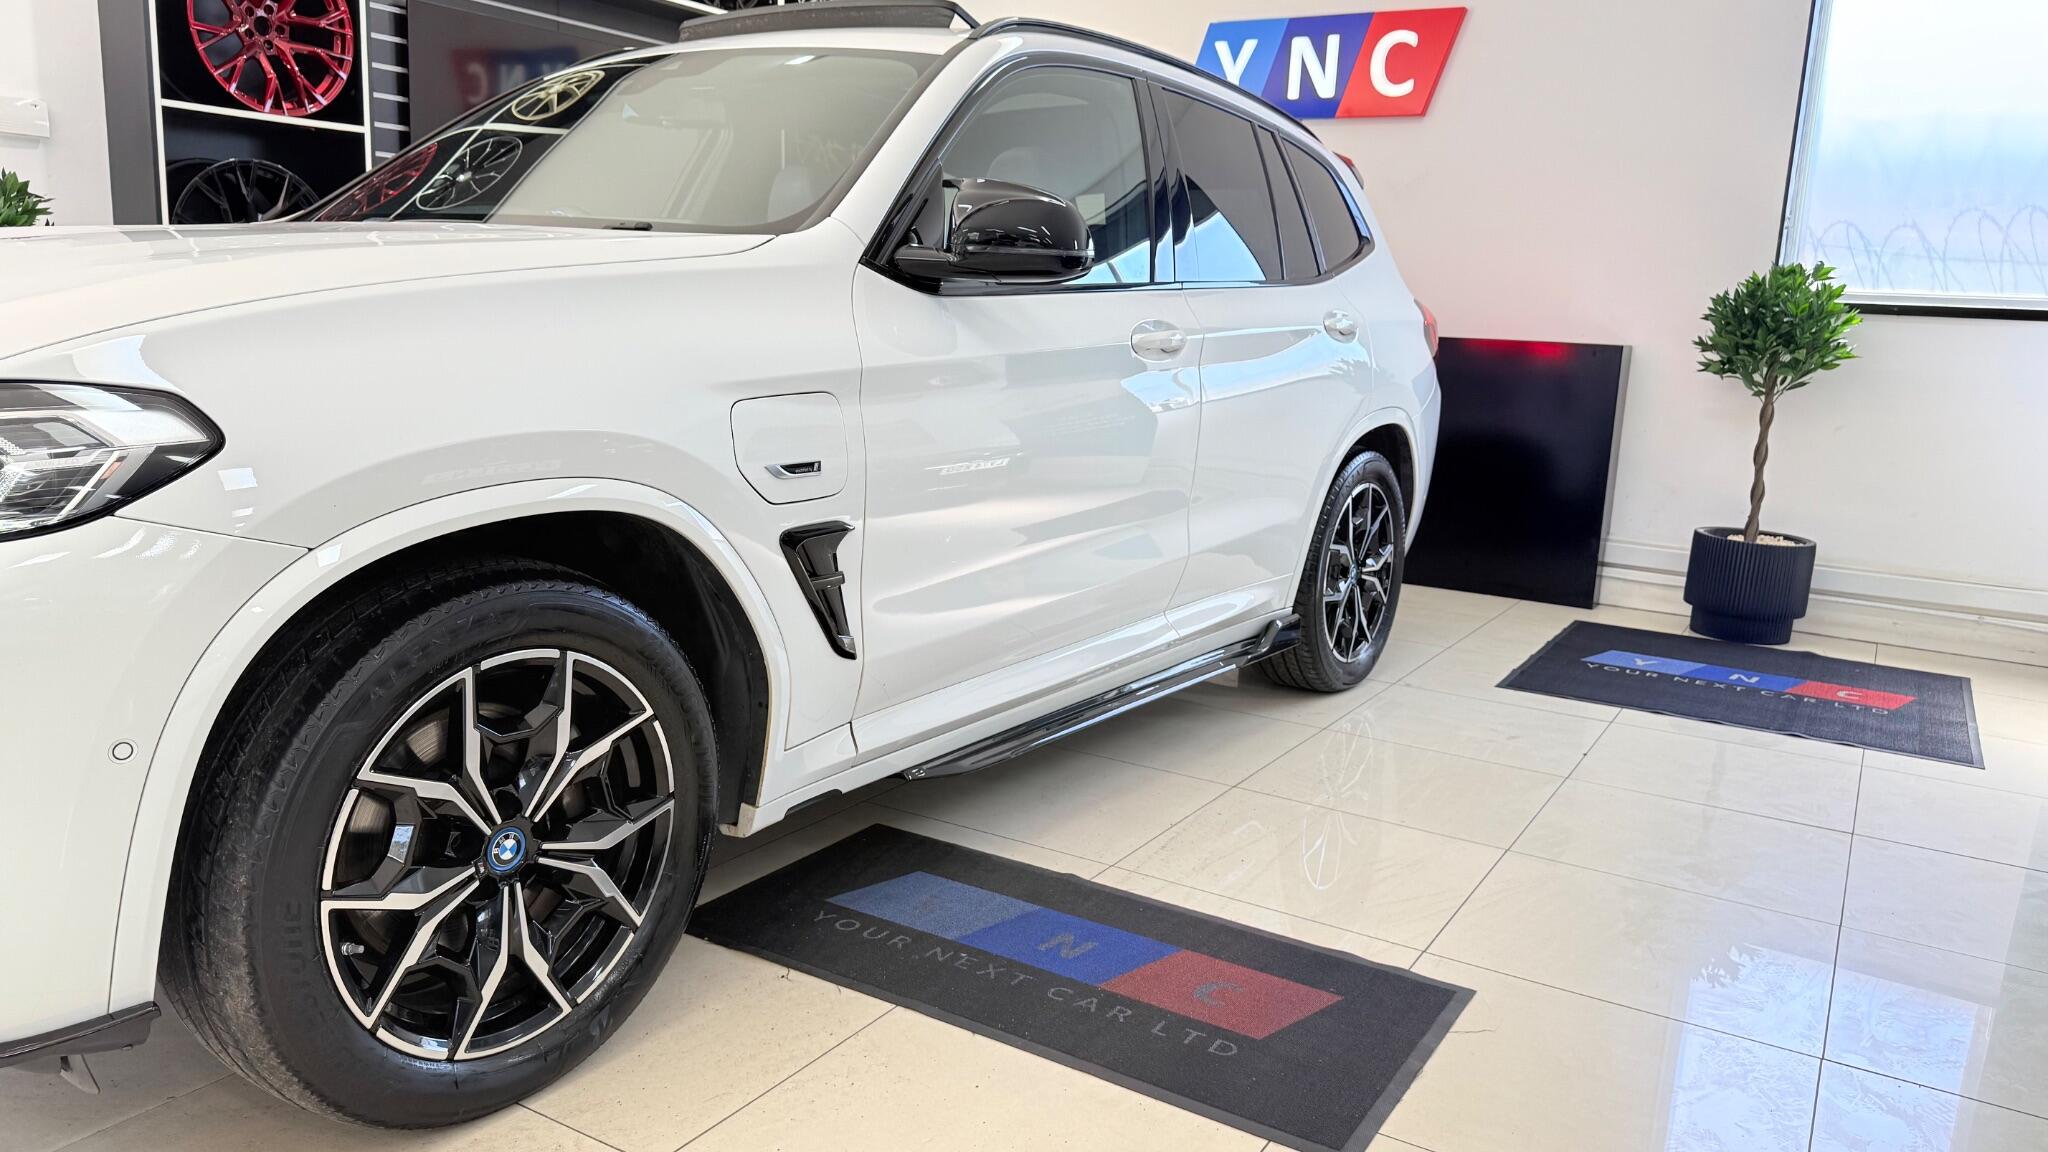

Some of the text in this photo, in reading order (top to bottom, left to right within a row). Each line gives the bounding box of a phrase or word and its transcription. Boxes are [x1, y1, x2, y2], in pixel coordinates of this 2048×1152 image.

[1214, 28, 1419, 100] YNC
[1587, 662, 1888, 715] YOUR NEXT CAR LTD
[814, 910, 1238, 1056] YOUR NEXT CAR LTD
